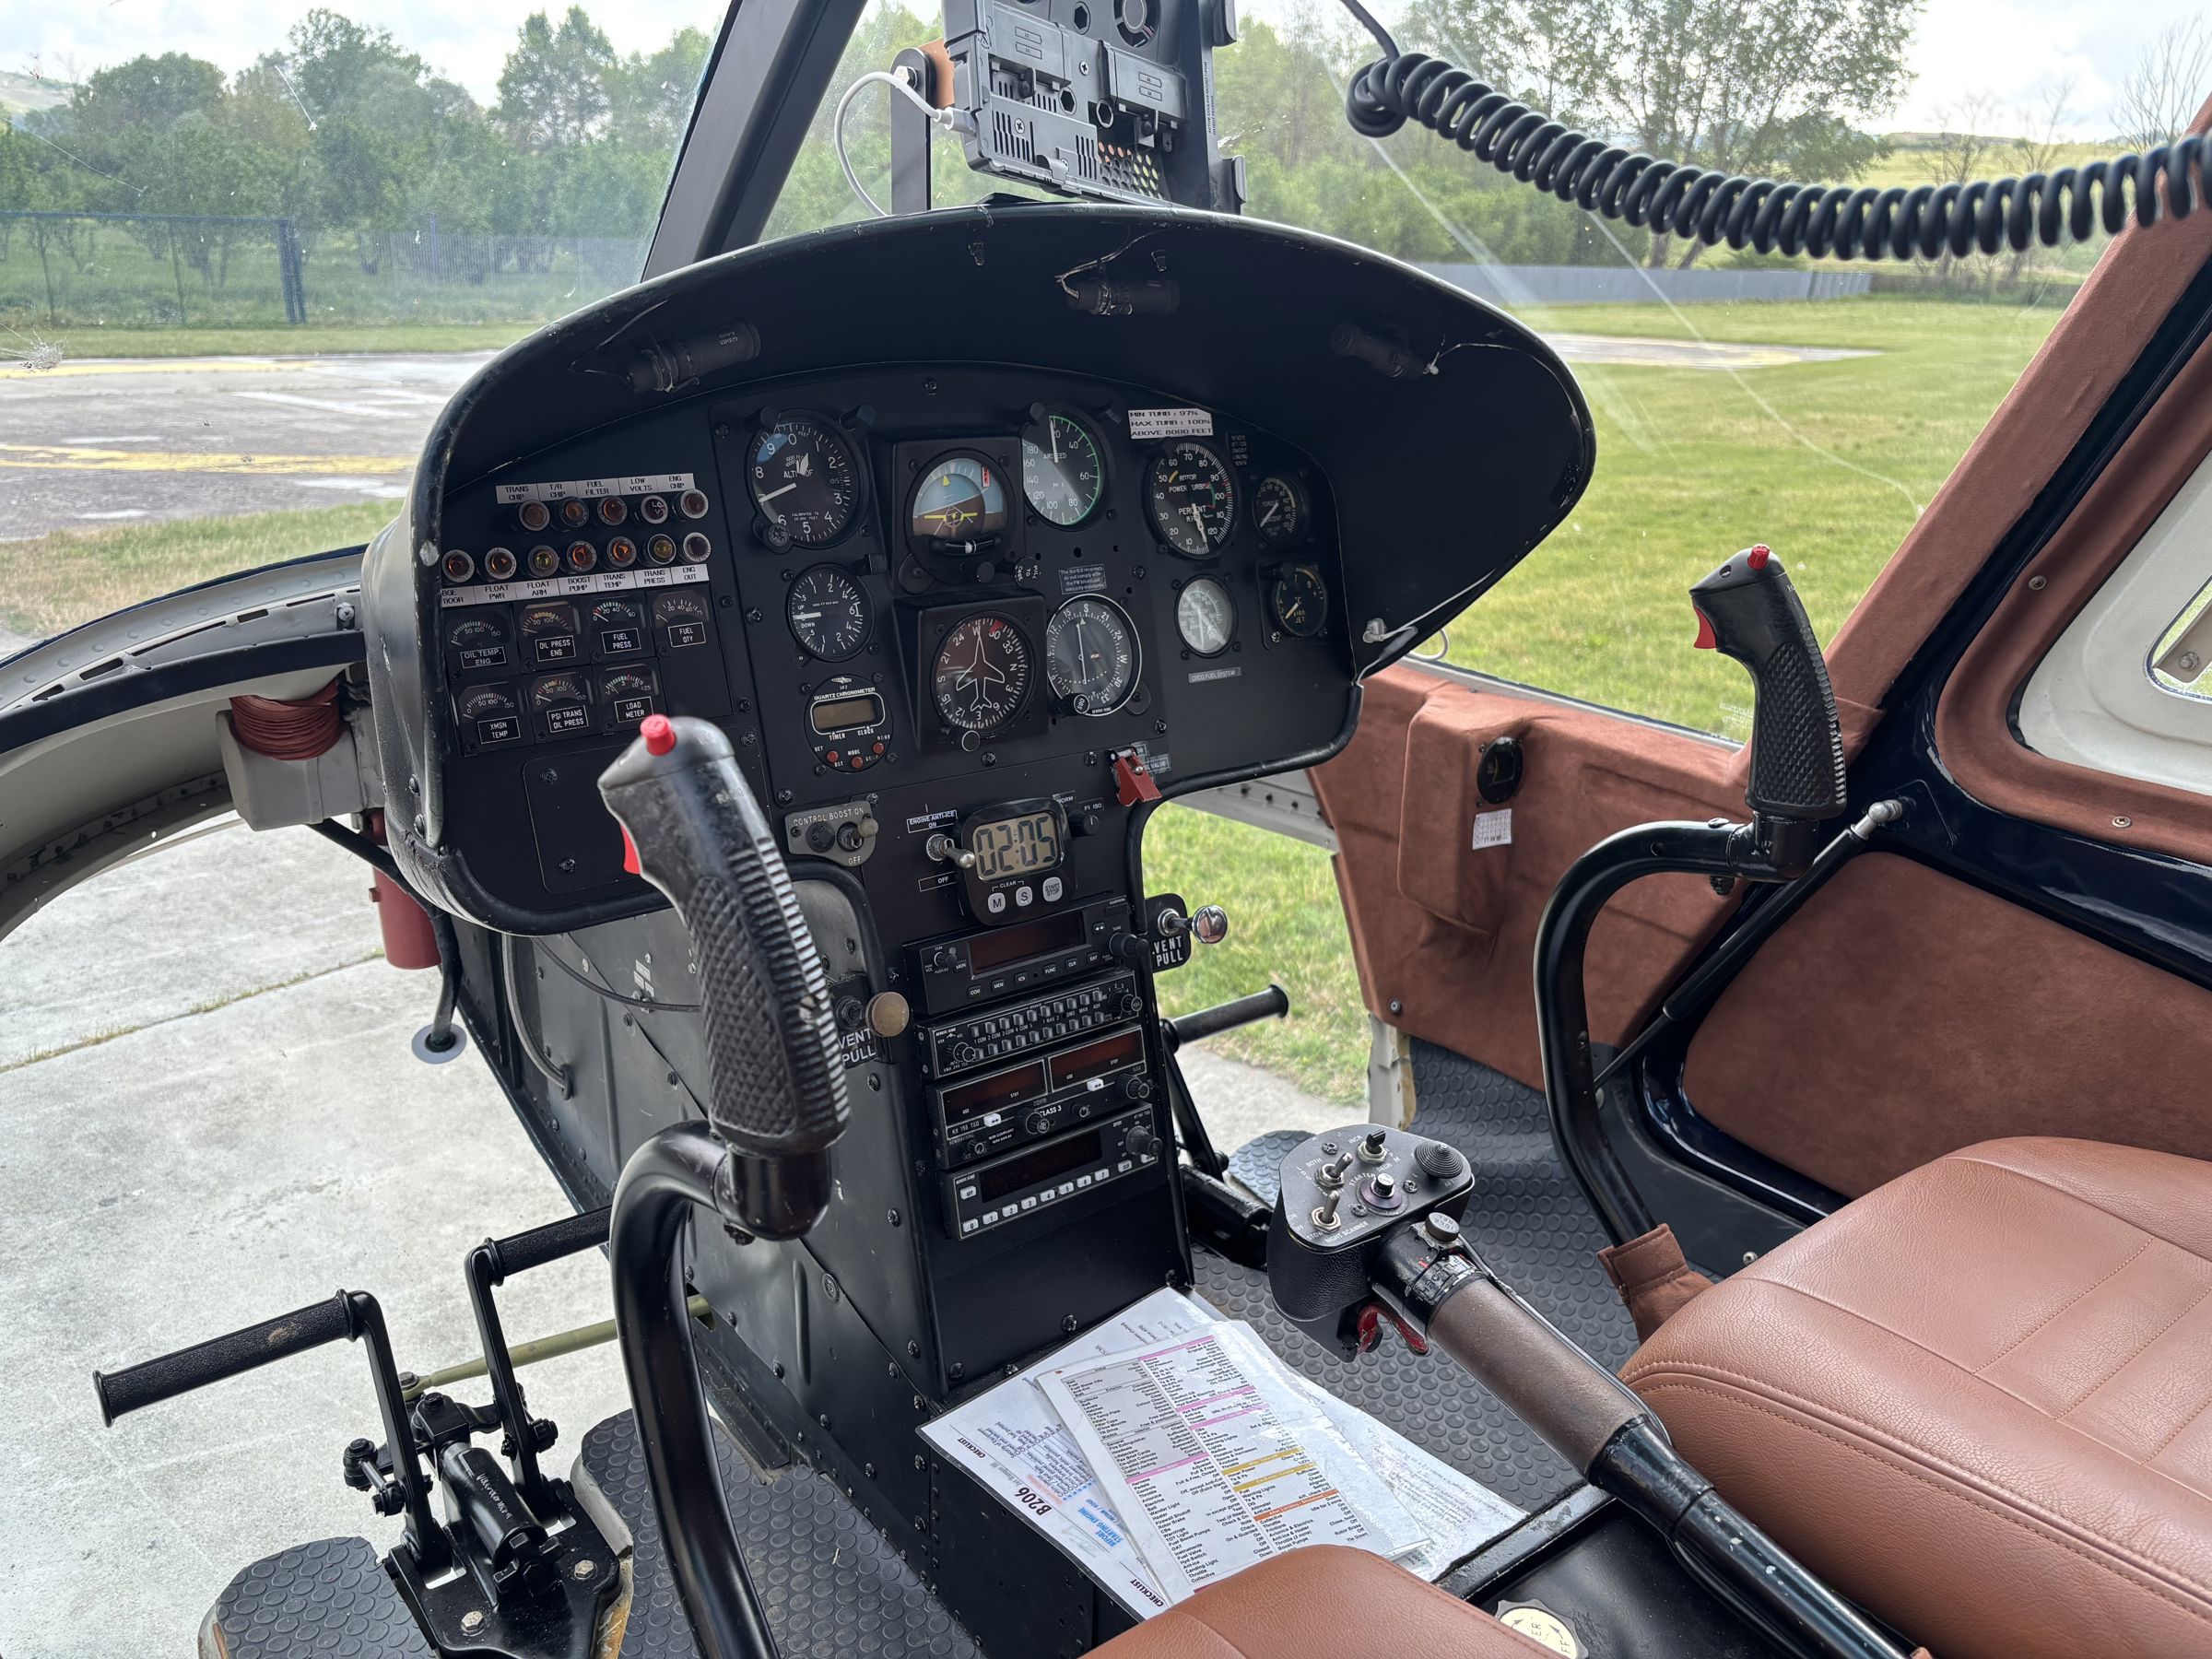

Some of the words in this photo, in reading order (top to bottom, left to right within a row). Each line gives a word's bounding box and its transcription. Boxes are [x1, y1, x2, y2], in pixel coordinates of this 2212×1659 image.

[788, 433, 797, 445] 0
[767, 443, 776, 454] 9
[1069, 441, 1078, 450] 40
[828, 456, 837, 469] 2
[756, 466, 764, 478] 8
[1080, 472, 1089, 480] 60
[833, 493, 842, 504] 3
[1032, 491, 1044, 500] 120
[1046, 501, 1058, 510] 100
[1068, 499, 1077, 507] 80
[803, 522, 811, 534] 5
[1170, 527, 1179, 535] 20
[527, 581, 549, 589] FLOAT
[568, 576, 591, 584] BOOST
[485, 584, 510, 593] FLOAT
[828, 583, 833, 592] 2
[849, 606, 855, 615] 6
[1083, 604, 1089, 613] S
[1100, 611, 1110, 621] 21
[953, 633, 965, 646] 24
[1003, 640, 1013, 653] 33
[941, 652, 951, 664] 21
[1120, 654, 1128, 664] W
[836, 688, 875, 698] CHRONOMETER
[626, 701, 641, 710] LOAD
[562, 710, 582, 718] TRANS
[625, 710, 645, 718] METER
[976, 711, 981, 720] E
[490, 722, 507, 730] XMSN
[564, 718, 584, 726] PRESS
[491, 731, 508, 739] TEMP
[830, 733, 845, 741] TIMER
[794, 815, 827, 827] CONTROL
[830, 808, 852, 820] BOOST
[910, 817, 930, 825] ENGINE
[931, 812, 955, 821] ANTI-ICE
[976, 816, 1056, 876] 02:05
[848, 856, 861, 865] OFF
[1045, 883, 1060, 893] START
[1046, 888, 1060, 897] STOP
[1021, 891, 1028, 901] S
[993, 898, 1002, 908] M
[1154, 935, 1182, 954] VENT
[1157, 949, 1182, 967] PULL
[838, 1028, 871, 1049] VENT
[841, 1045, 876, 1066] PULL
[1306, 1158, 1322, 1167] BOTH
[1348, 1172, 1376, 1187] STARTER
[1324, 1233, 1342, 1243] NIGHT
[1342, 1221, 1370, 1236] SCANNER
[957, 1437, 986, 1459] CHECKLIST
[1014, 1486, 1053, 1516] B206
[1077, 1507, 1098, 1526] ENGINE
[1095, 1518, 1124, 1544] STARTING
[1095, 1530, 1117, 1547] BEFORE
[1130, 1578, 1164, 1608] CHECKLIST
